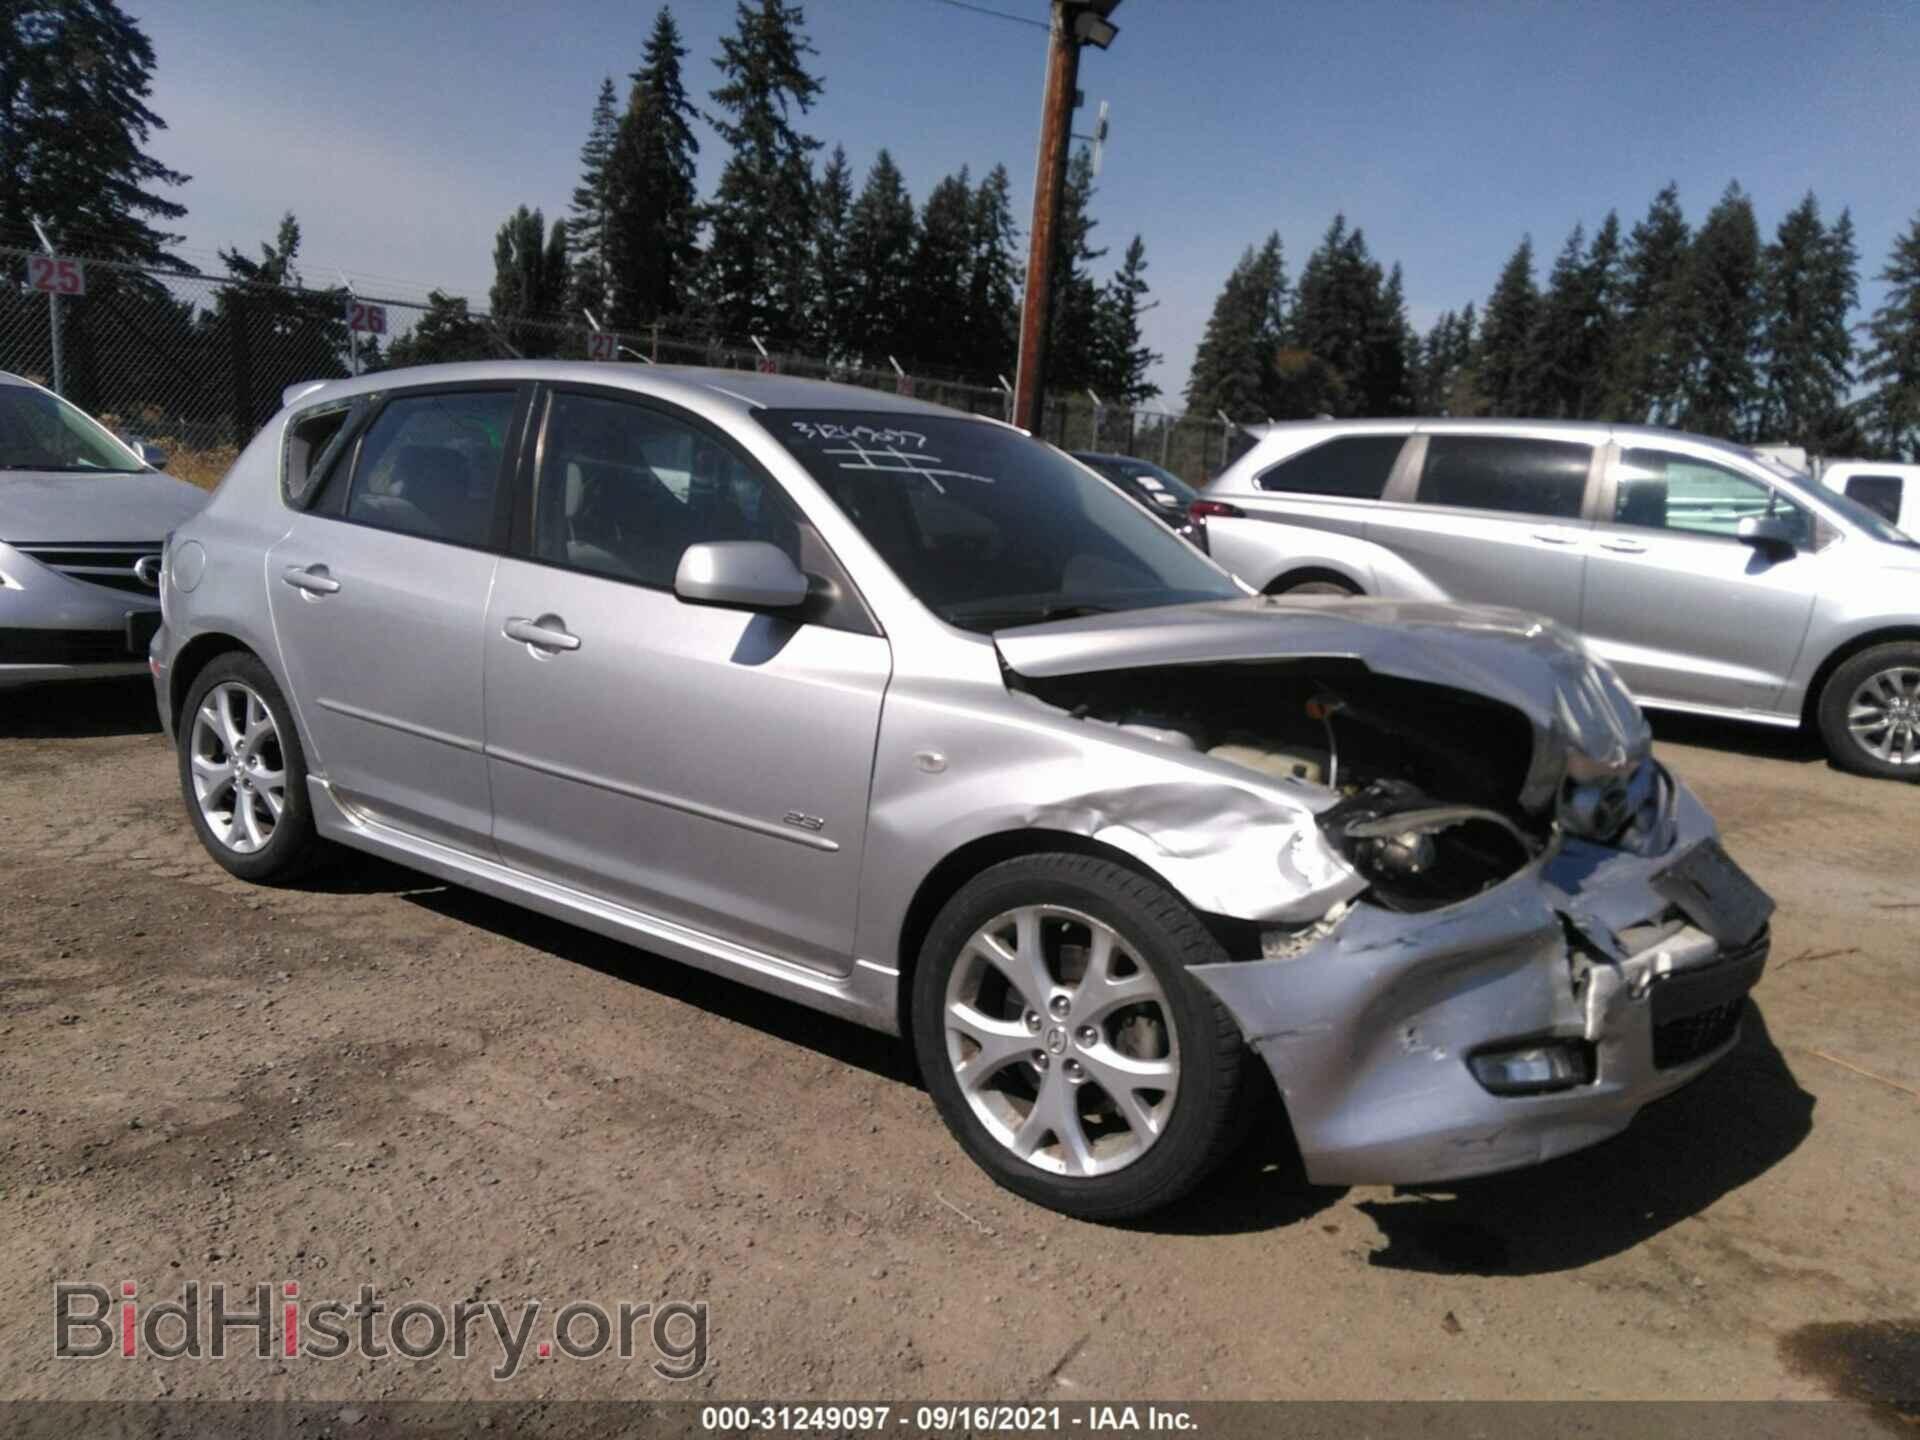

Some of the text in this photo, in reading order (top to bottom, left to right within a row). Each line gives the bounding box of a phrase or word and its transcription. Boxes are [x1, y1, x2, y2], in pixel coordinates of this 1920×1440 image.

[32, 258, 81, 293] 25
[352, 304, 385, 333] 26
[593, 335, 614, 358] 27
